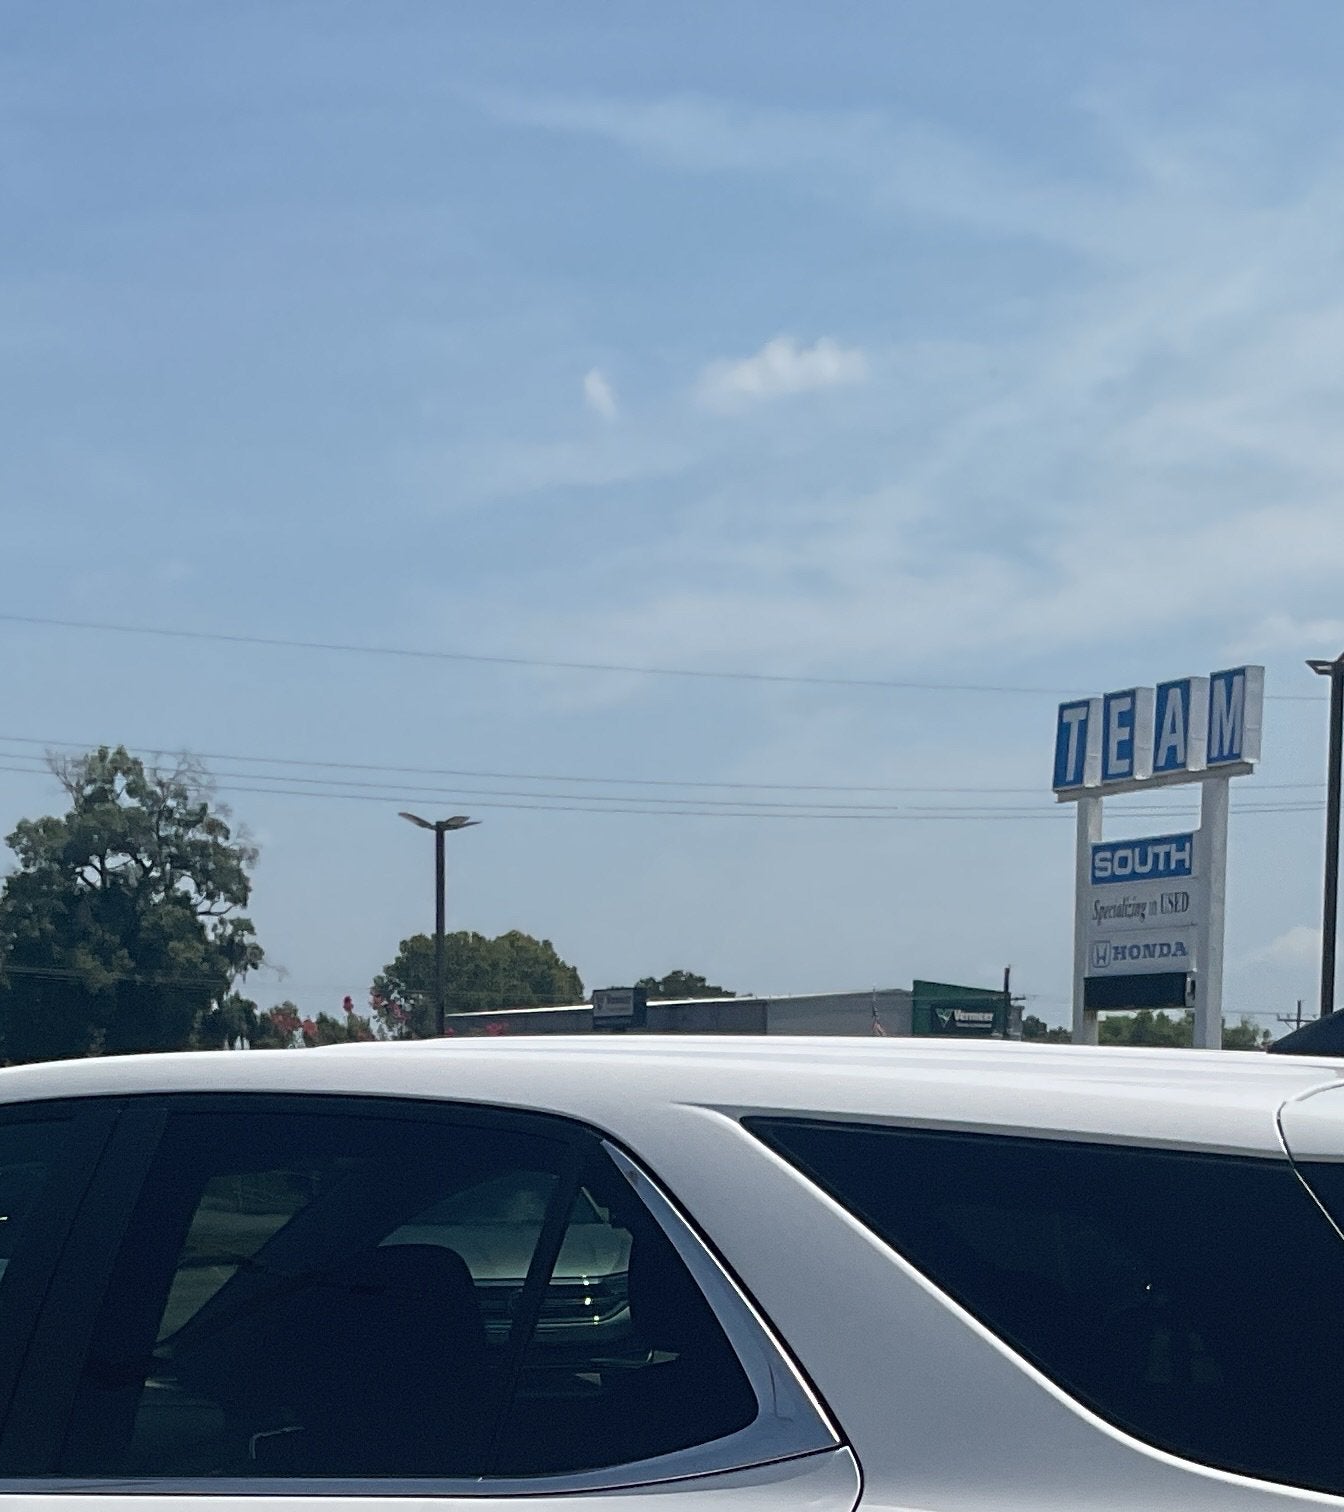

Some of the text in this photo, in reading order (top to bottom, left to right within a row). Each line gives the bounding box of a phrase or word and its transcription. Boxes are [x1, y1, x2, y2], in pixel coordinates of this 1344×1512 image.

[1061, 674, 1246, 782] TEAM
[1094, 842, 1191, 877] SOUTH
[1160, 891, 1190, 915] USED
[1112, 941, 1189, 961] HONDA
